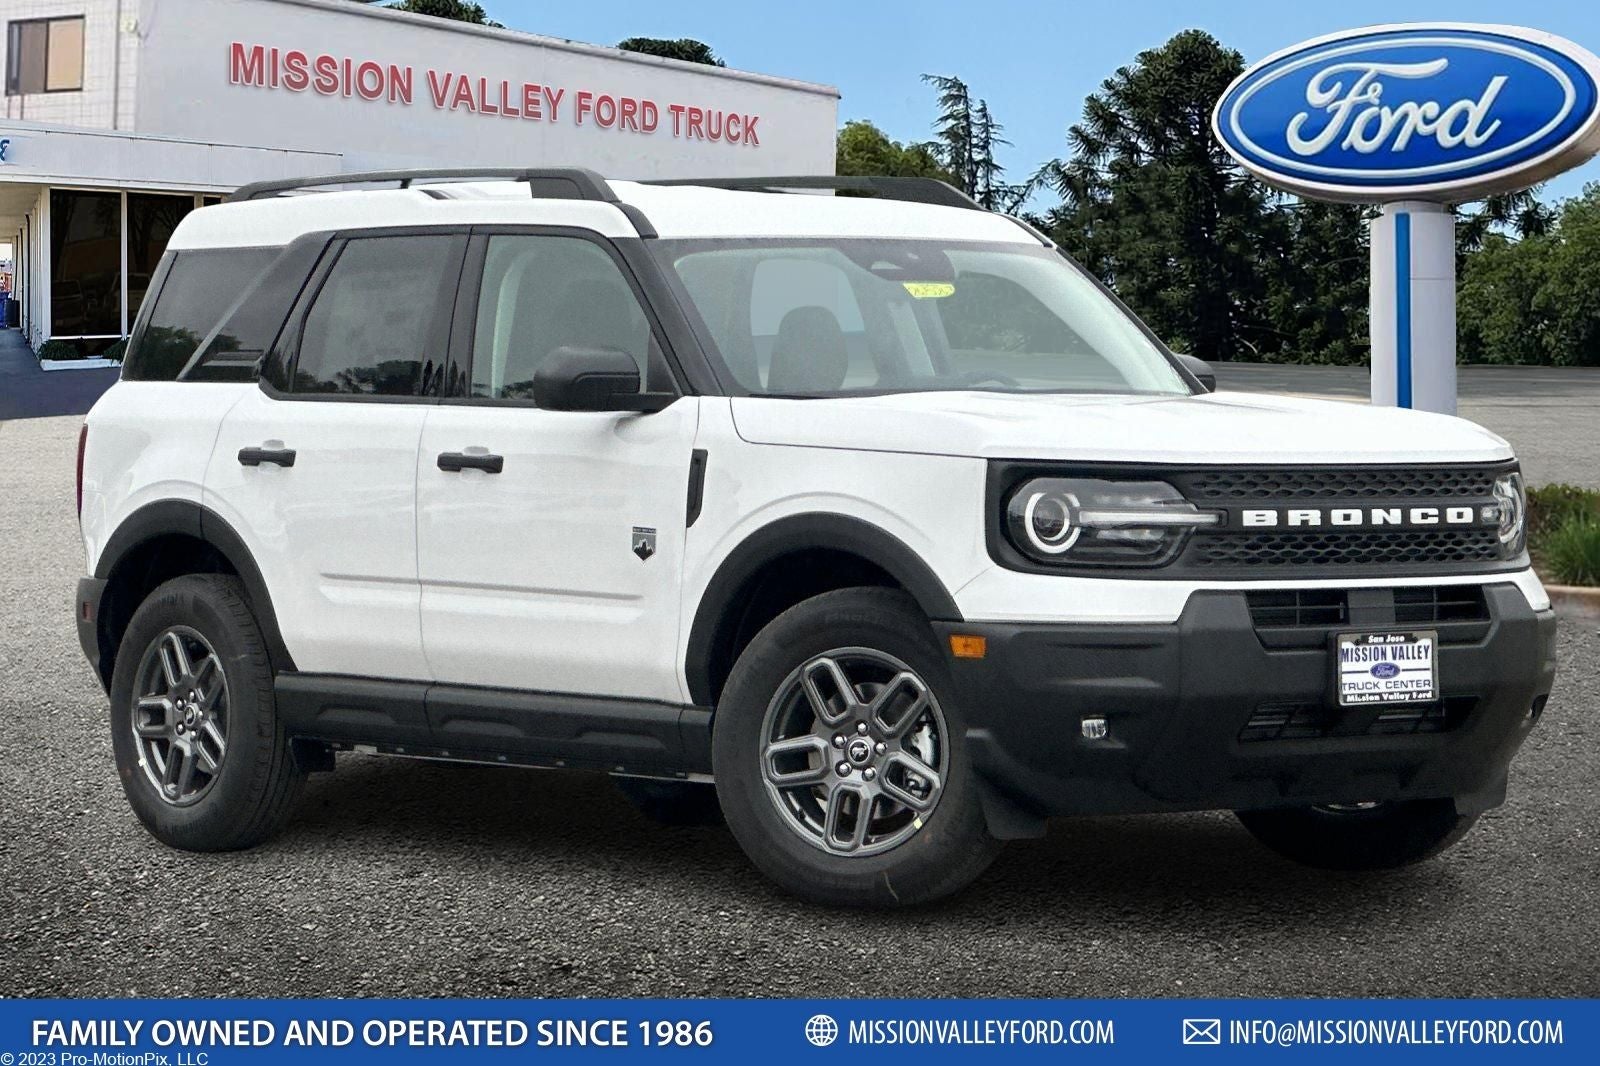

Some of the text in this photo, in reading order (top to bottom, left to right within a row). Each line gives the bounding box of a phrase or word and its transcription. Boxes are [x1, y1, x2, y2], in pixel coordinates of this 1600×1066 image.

[230, 41, 761, 146] MISSION VALLEY FORD TRUCK
[1286, 58, 1509, 156] Ford
[1242, 507, 1475, 528] BRONCO
[1368, 634, 1405, 643] San Jose
[1341, 645, 1430, 662] MISSION VALLEY
[1342, 679, 1431, 691] TRUCK CENTER
